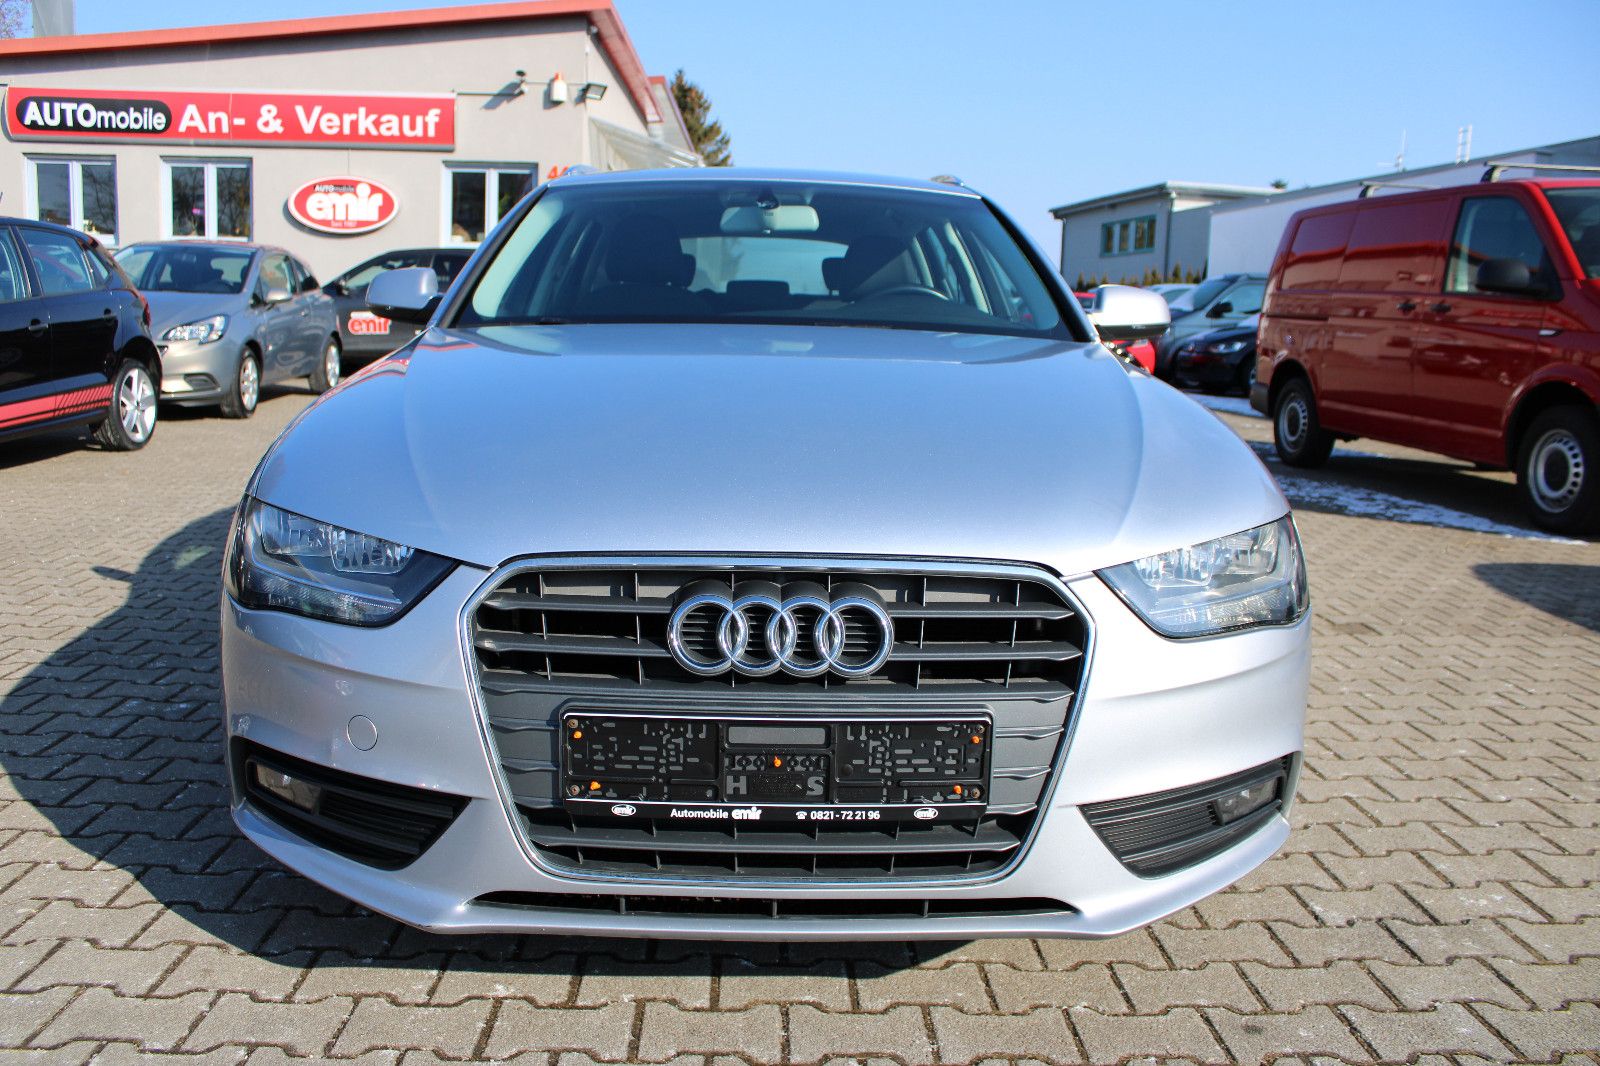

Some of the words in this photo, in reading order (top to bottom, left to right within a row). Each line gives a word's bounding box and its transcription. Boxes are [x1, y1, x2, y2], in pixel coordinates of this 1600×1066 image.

[24, 101, 167, 131] AUTOmobile
[178, 104, 246, 134] An-
[256, 104, 285, 134] &
[295, 105, 441, 138] Verkauf
[306, 183, 383, 221] emir
[348, 317, 391, 335] emir
[670, 808, 729, 819] Automobile
[732, 806, 762, 820] emir
